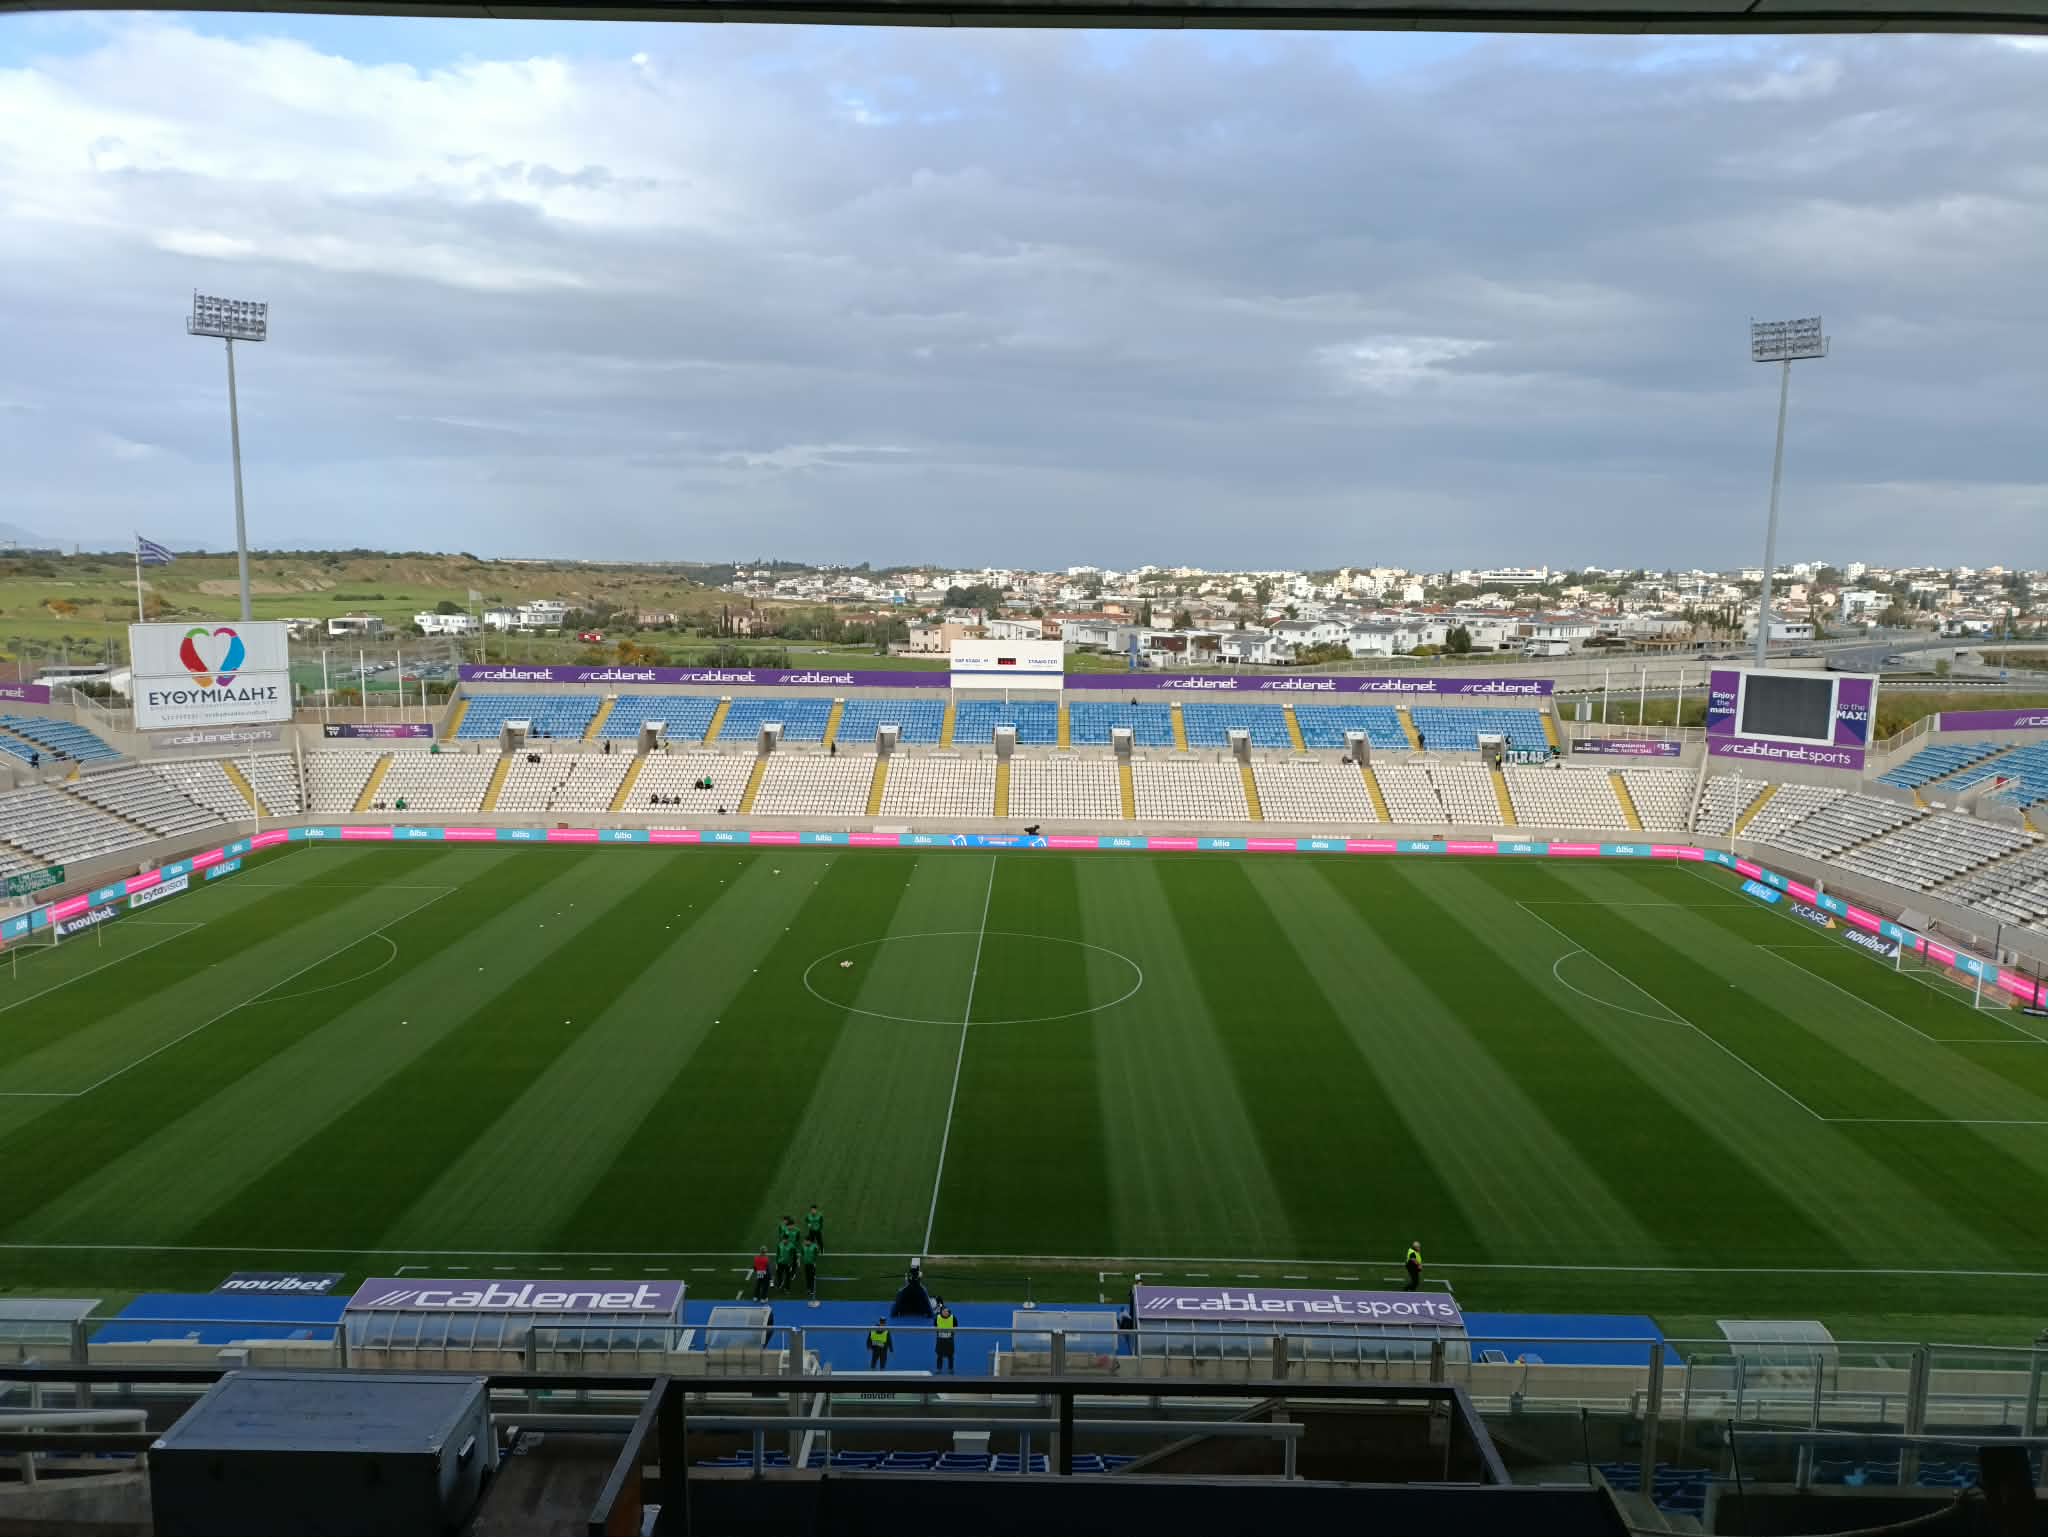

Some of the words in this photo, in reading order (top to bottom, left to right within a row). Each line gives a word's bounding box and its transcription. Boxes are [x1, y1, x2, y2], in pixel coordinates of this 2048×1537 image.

[485, 668, 553, 680] cablenet
[588, 669, 656, 681] cablenet
[692, 670, 756, 682] cablenet
[790, 672, 855, 684] cablenet
[1172, 676, 1238, 689] cablenet
[1271, 678, 1337, 690] cablenet
[1370, 679, 1437, 692] cablenet
[1472, 680, 1542, 693] cablenet
[149, 686, 278, 705] ΕΥΘΥΜΙΑΔΗΣ
[1712, 691, 1736, 701] Enjoy
[1836, 711, 1867, 721] MAX!
[67, 905, 116, 932] novibet
[1845, 930, 1891, 954] novibet
[221, 1277, 332, 1290] novibet
[415, 1283, 661, 1309] cablenet
